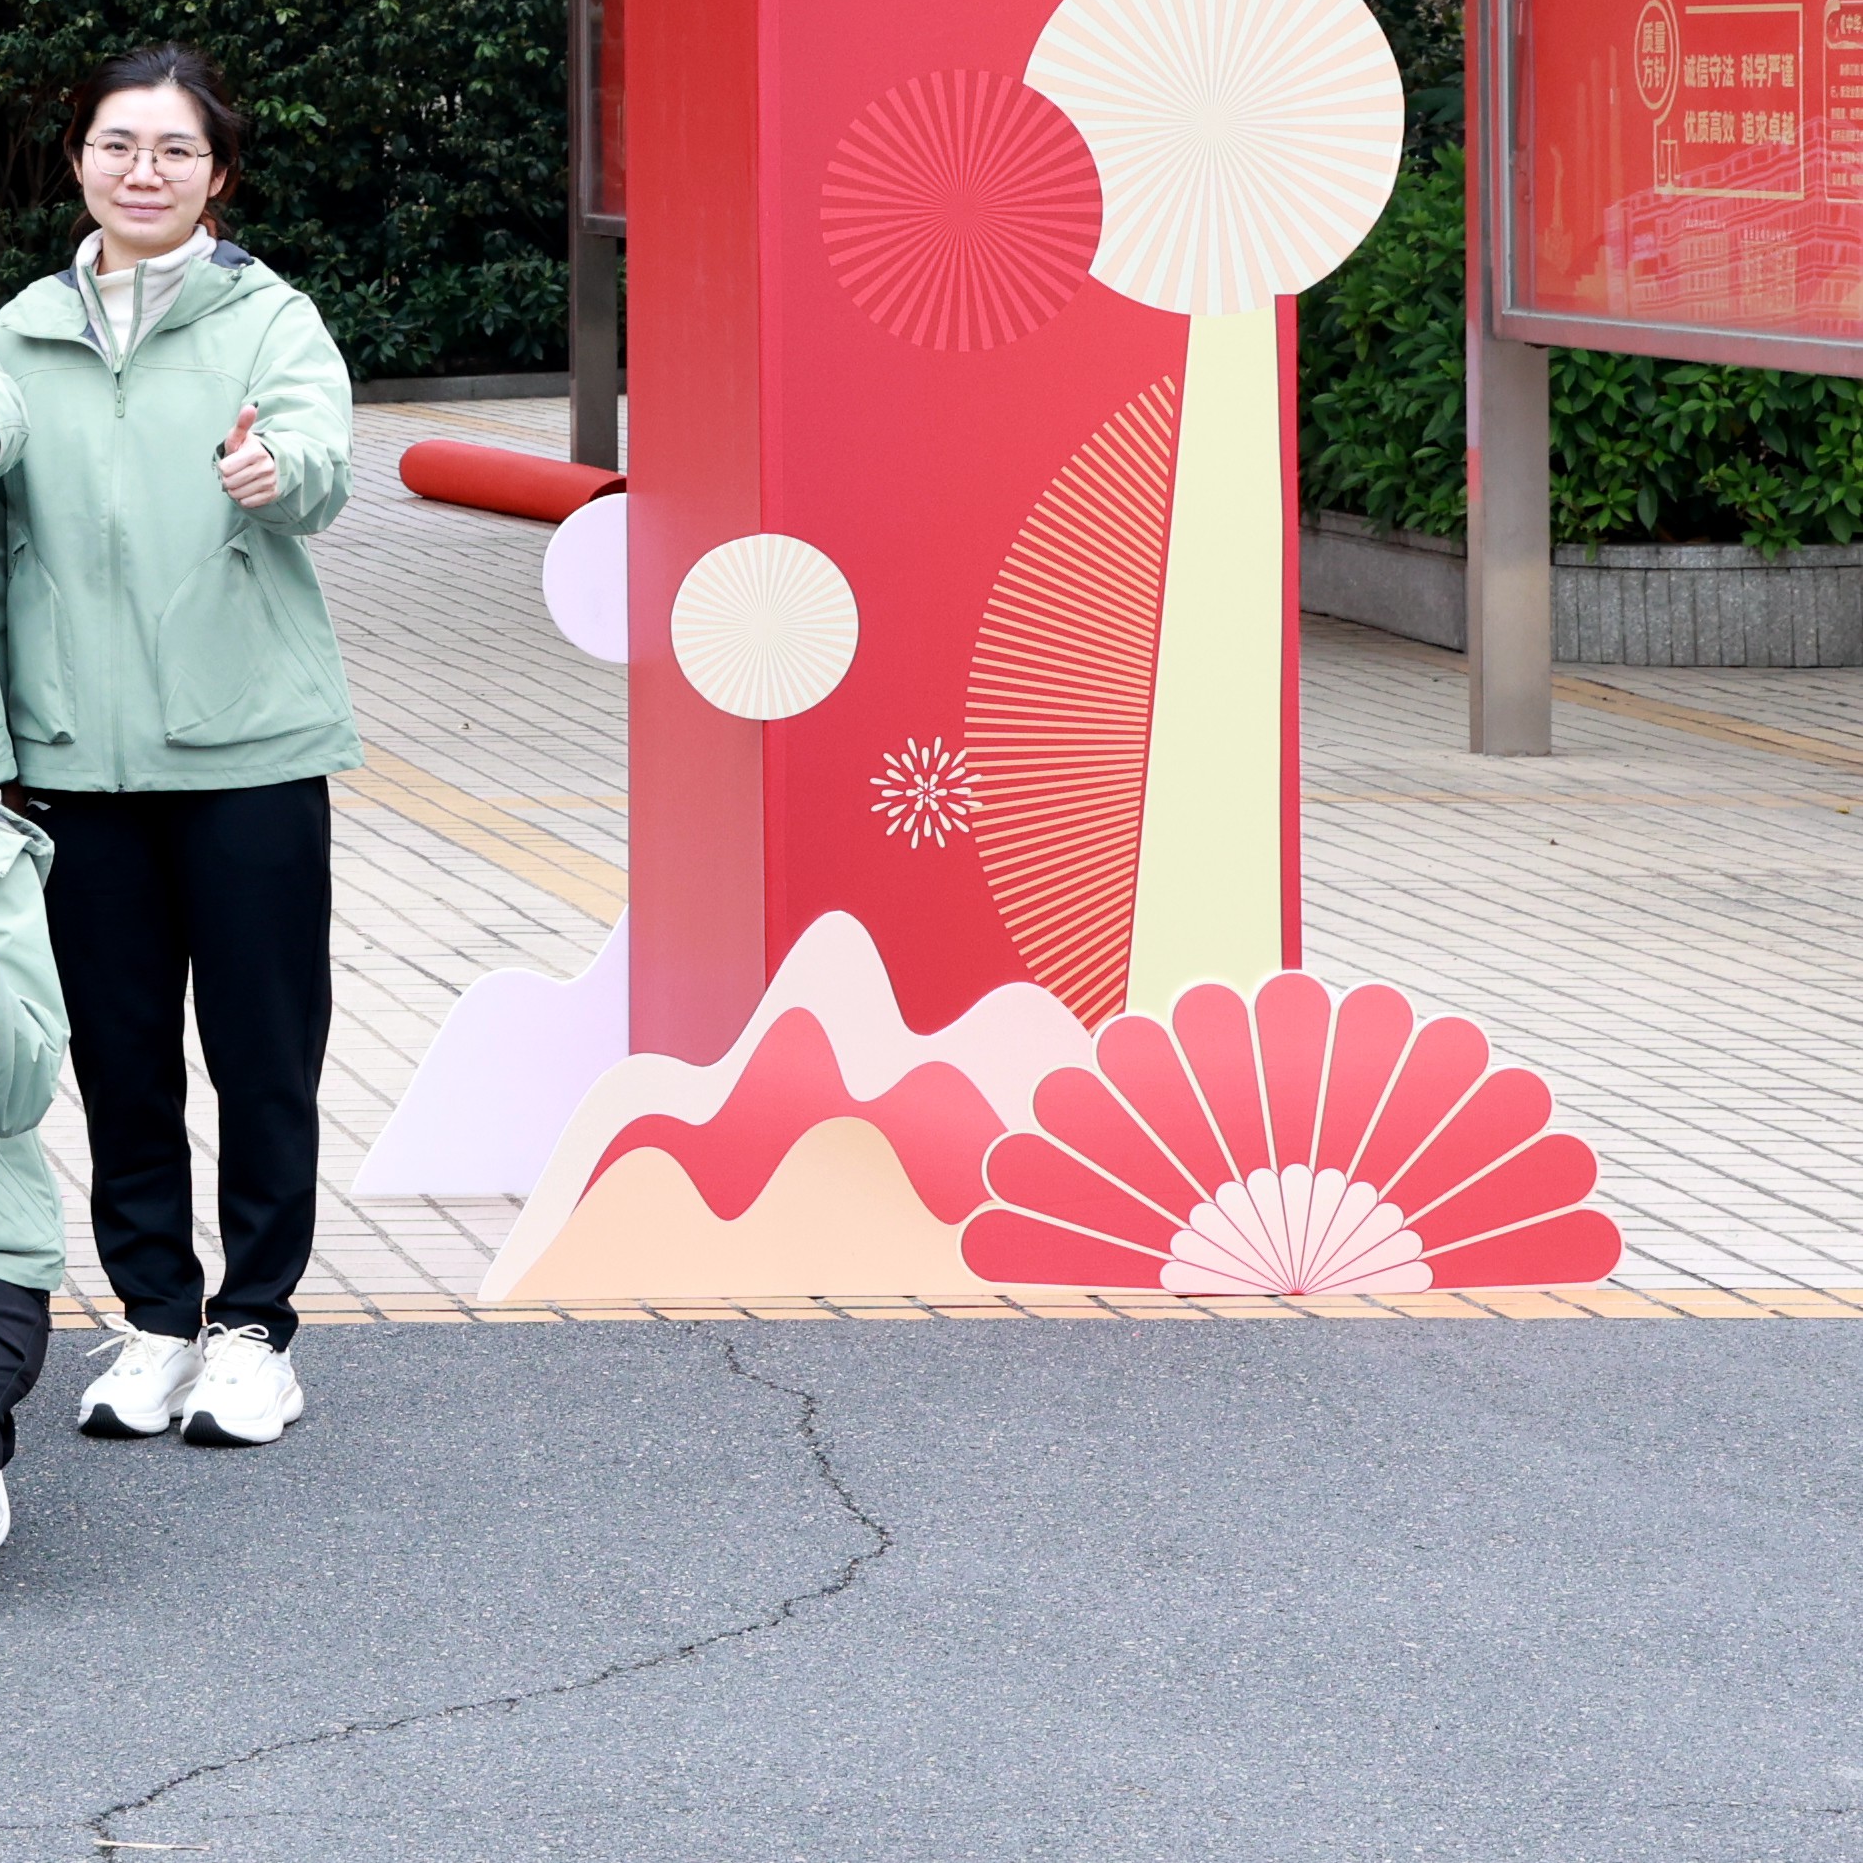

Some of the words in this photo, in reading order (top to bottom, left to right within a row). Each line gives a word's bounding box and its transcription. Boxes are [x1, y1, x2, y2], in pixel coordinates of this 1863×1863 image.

[1641, 21, 1667, 54] 质量
[1641, 56, 1667, 88] 方针
[1684, 54, 1735, 88] 诚信守法
[1741, 54, 1795, 88] 科学严谨
[1684, 110, 1736, 144] 优质高效
[1741, 111, 1796, 146] 追求卓越
